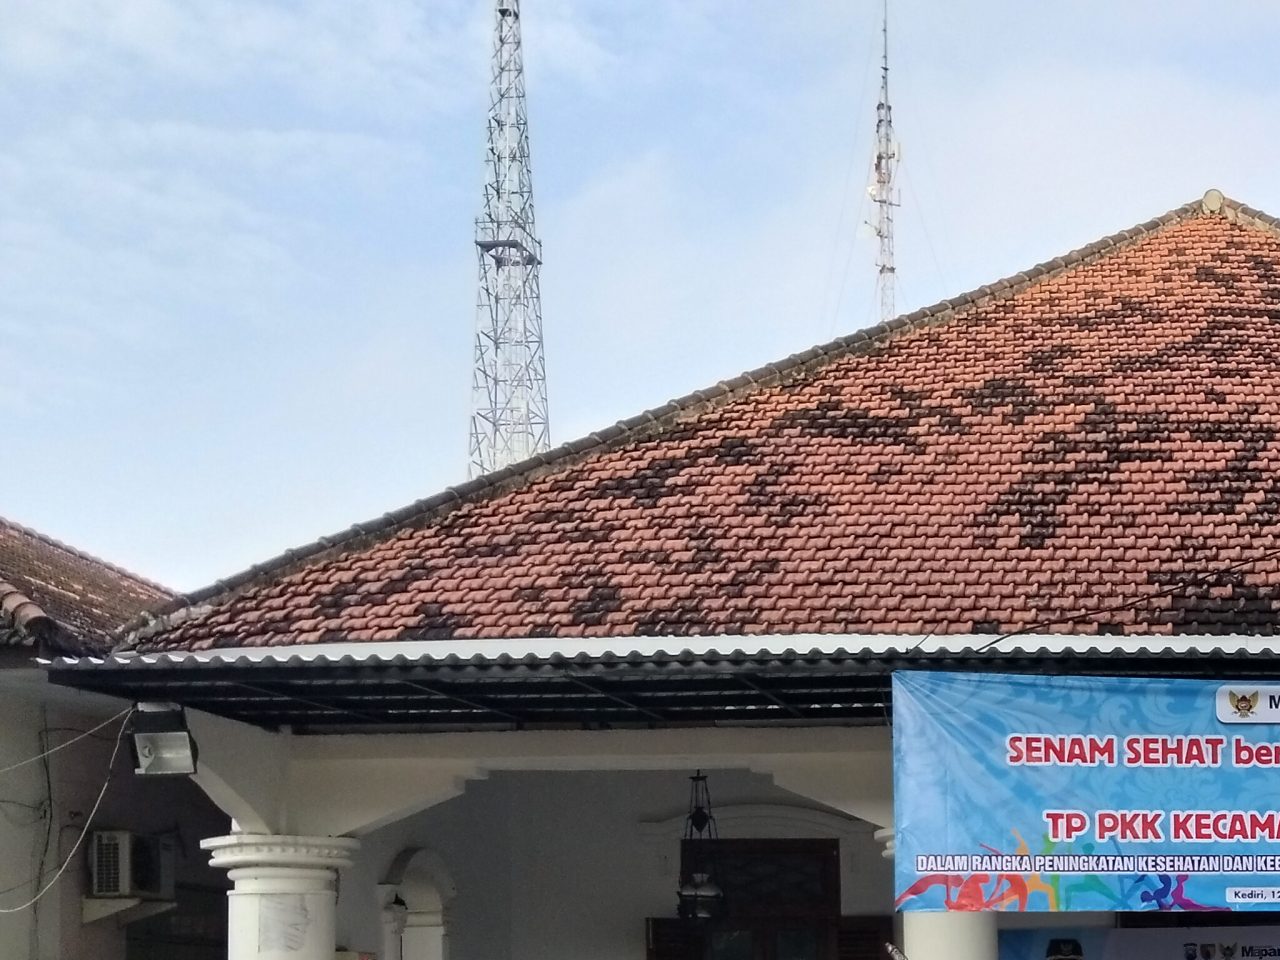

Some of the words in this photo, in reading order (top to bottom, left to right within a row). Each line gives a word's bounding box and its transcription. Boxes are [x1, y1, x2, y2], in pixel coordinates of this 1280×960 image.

[1008, 736, 1114, 764] SENAM
[1126, 738, 1224, 764] SEHAT
[1046, 813, 1087, 839] TP
[1099, 813, 1162, 840] PKK
[917, 855, 968, 871] DALAM
[972, 855, 1032, 871] RANGKA
[1036, 855, 1134, 872] PENINGKATAN
[1138, 855, 1219, 872] KESEHATAN
[1223, 855, 1252, 871] DAN
[1234, 890, 1267, 900] Kediri,
